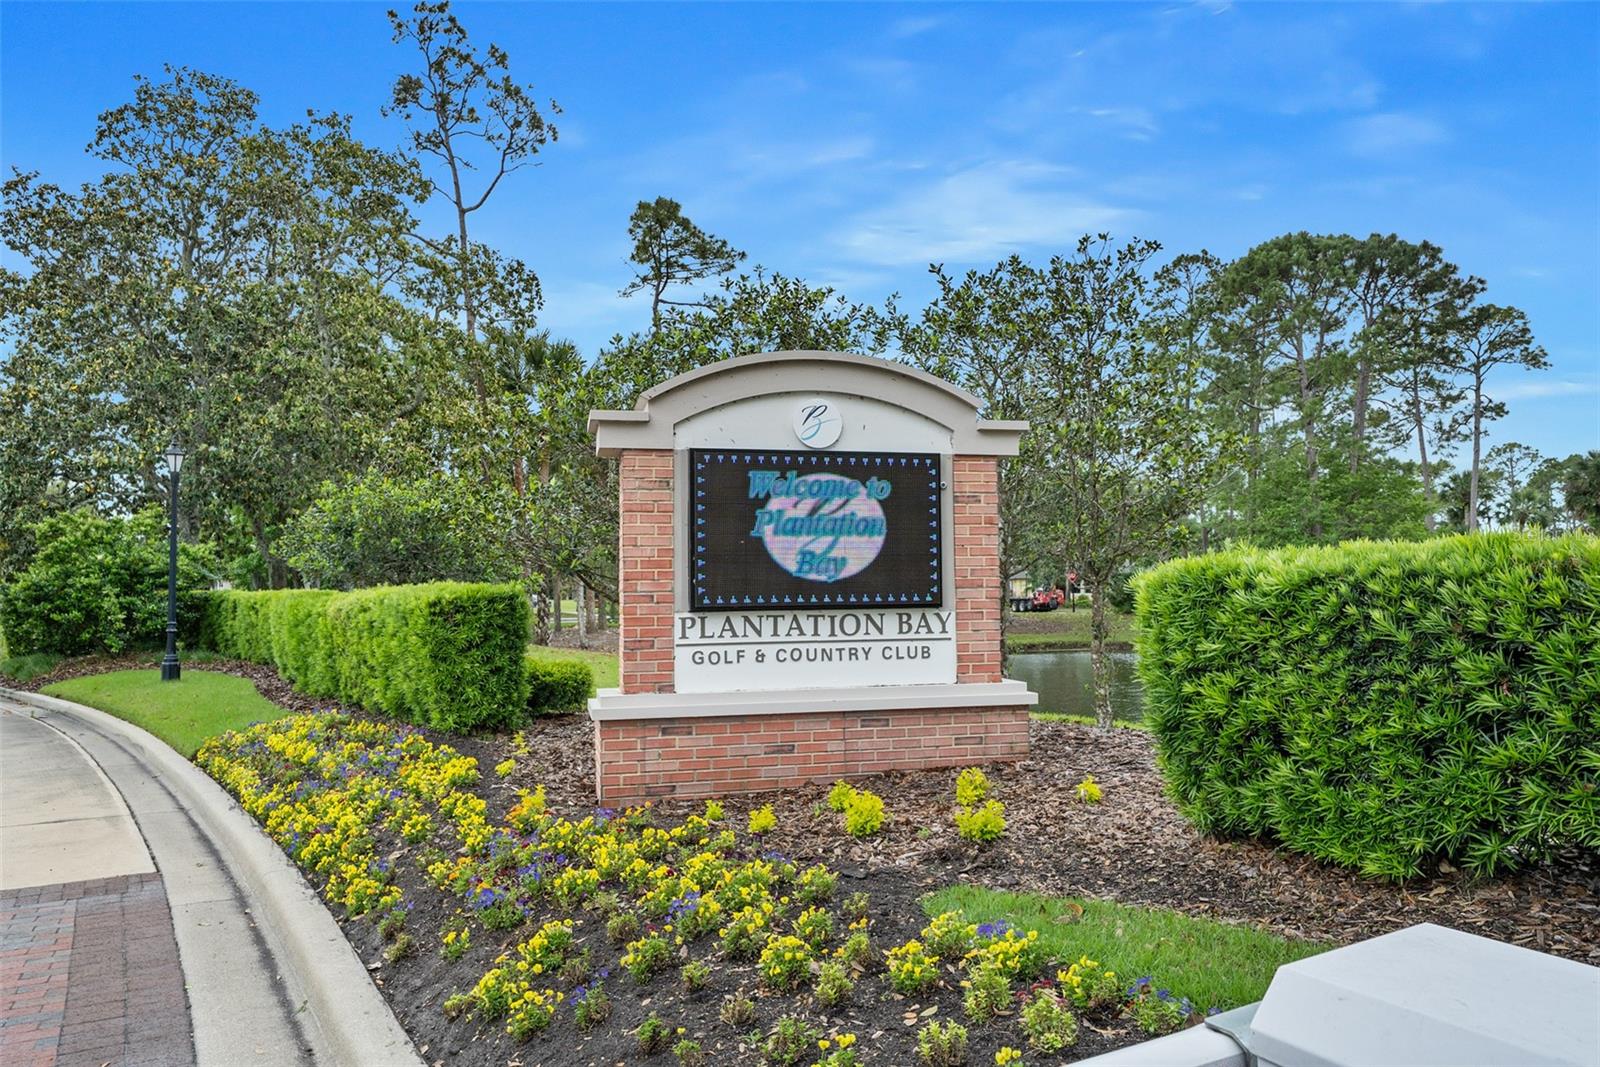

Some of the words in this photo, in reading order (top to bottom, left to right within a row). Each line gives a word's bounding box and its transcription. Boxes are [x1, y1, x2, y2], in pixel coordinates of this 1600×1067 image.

[748, 470, 859, 499] Welcome
[863, 477, 892, 500] to
[750, 509, 887, 537] Plantation
[793, 550, 848, 582] Bay
[679, 613, 885, 639] PLANTATION
[896, 612, 952, 635] BAY
[692, 649, 746, 665] GOLF
[755, 650, 766, 664] &
[776, 648, 873, 663] COUNTRY
[882, 645, 931, 660] CLUB
